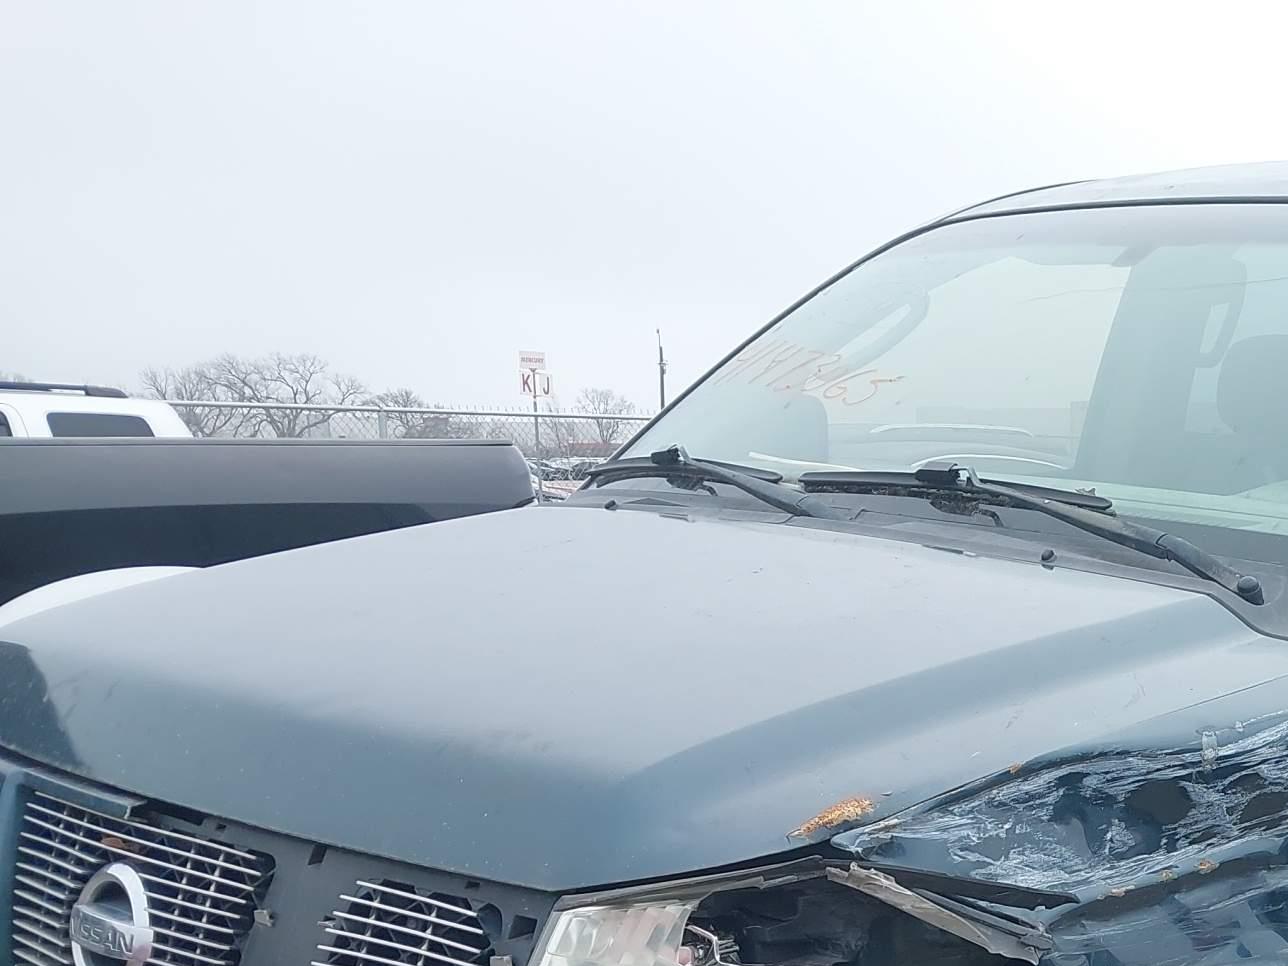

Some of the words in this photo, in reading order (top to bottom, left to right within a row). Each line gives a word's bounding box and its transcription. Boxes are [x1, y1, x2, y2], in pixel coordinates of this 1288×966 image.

[521, 373, 533, 393] K
[542, 376, 550, 395] J
[70, 911, 135, 956] NISSAN
